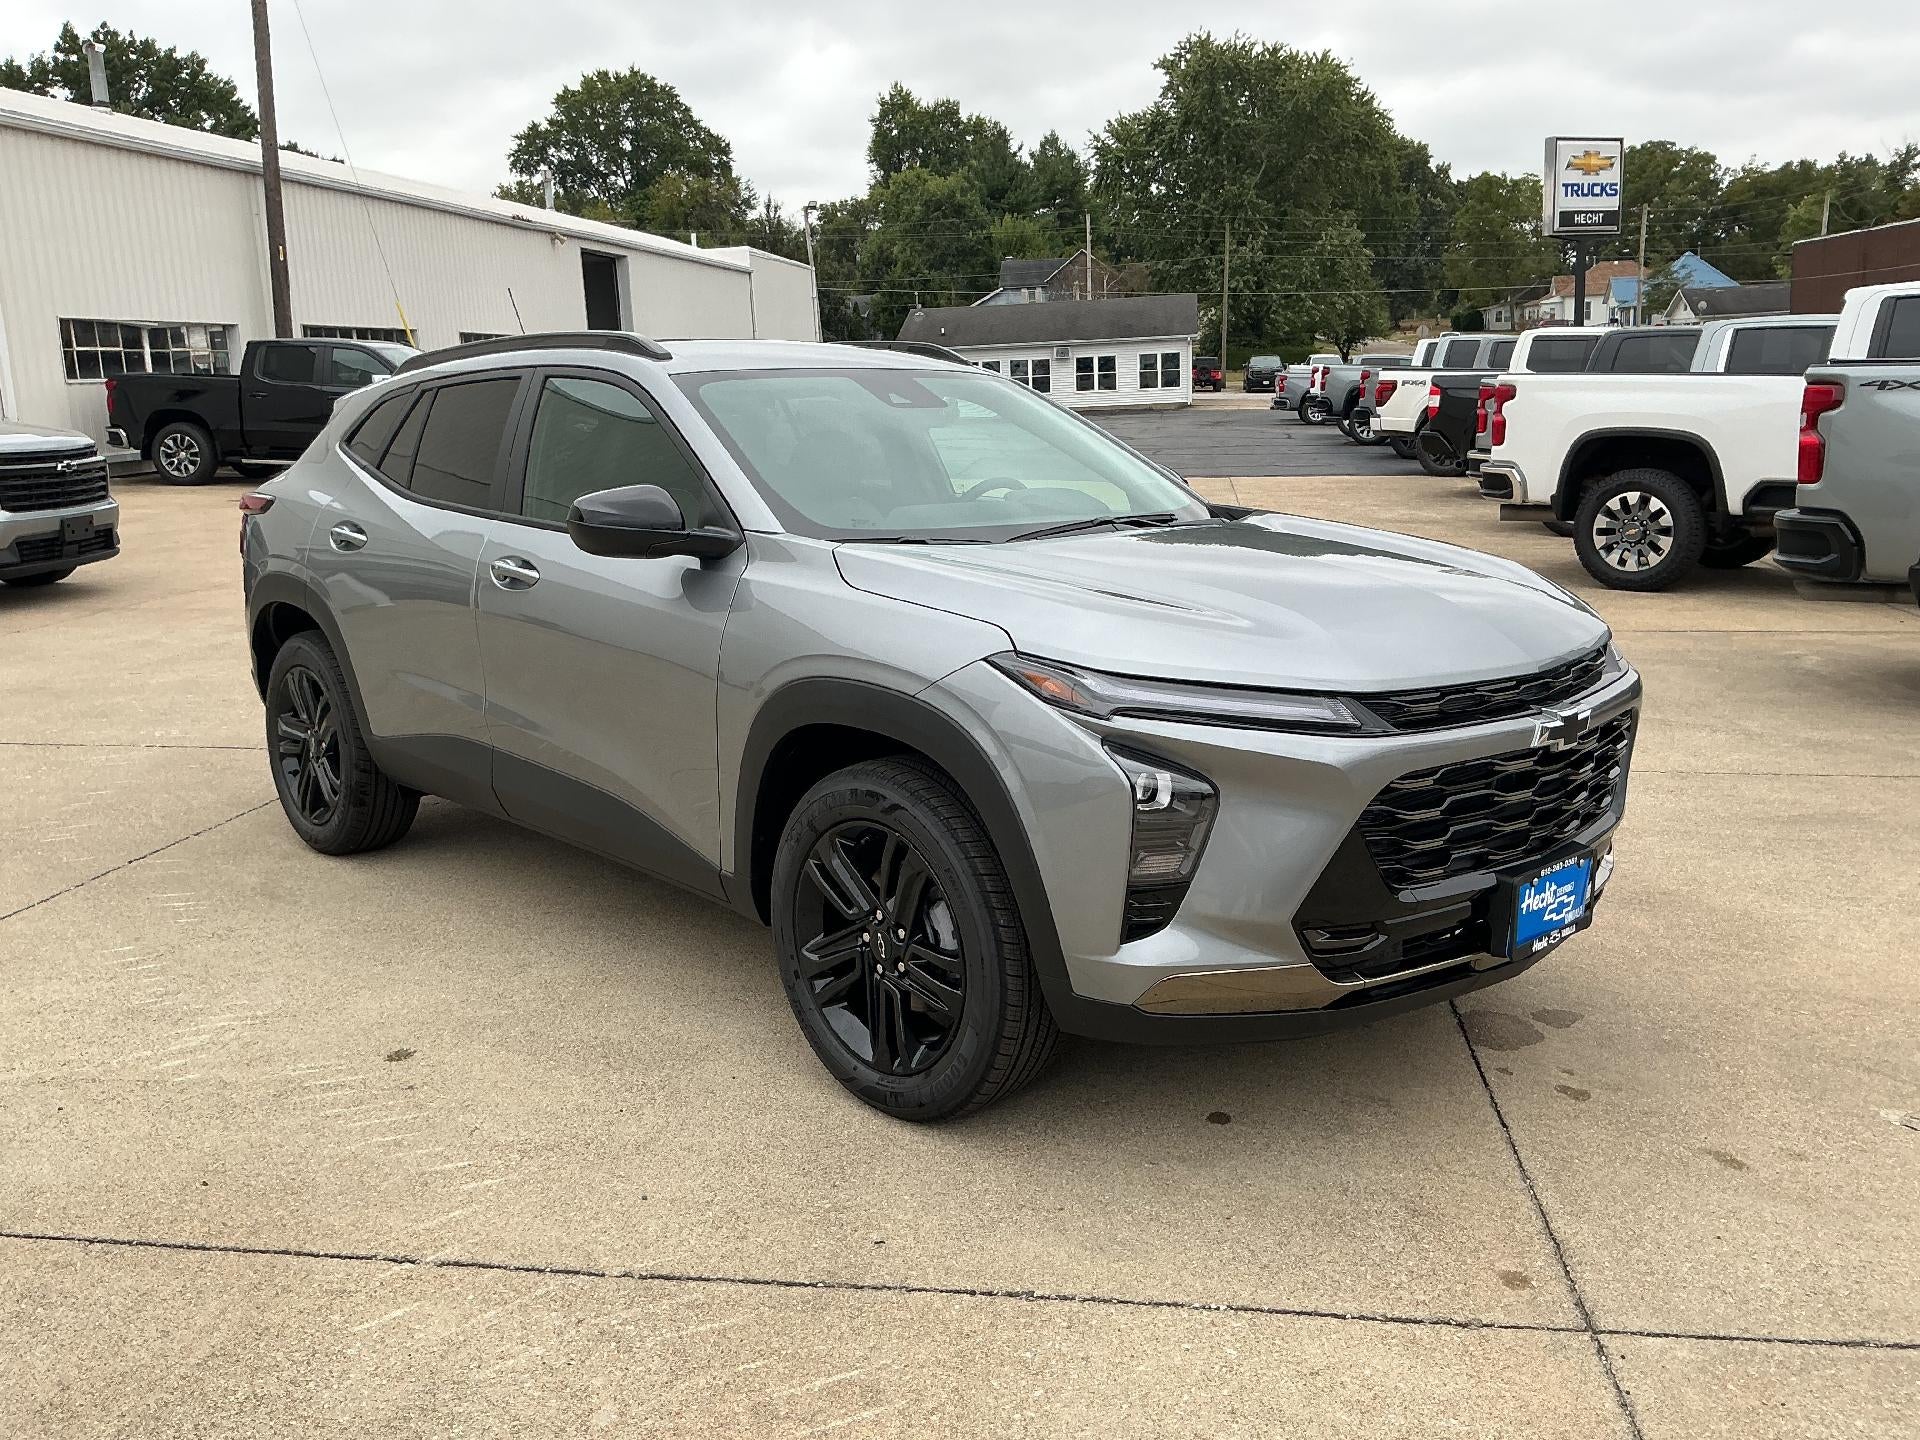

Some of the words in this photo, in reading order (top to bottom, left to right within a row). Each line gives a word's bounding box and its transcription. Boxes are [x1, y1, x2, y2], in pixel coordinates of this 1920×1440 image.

[1562, 182, 1618, 197] TRUCKS
[1574, 213, 1604, 224] HECHT
[1521, 881, 1557, 914] Hecht
